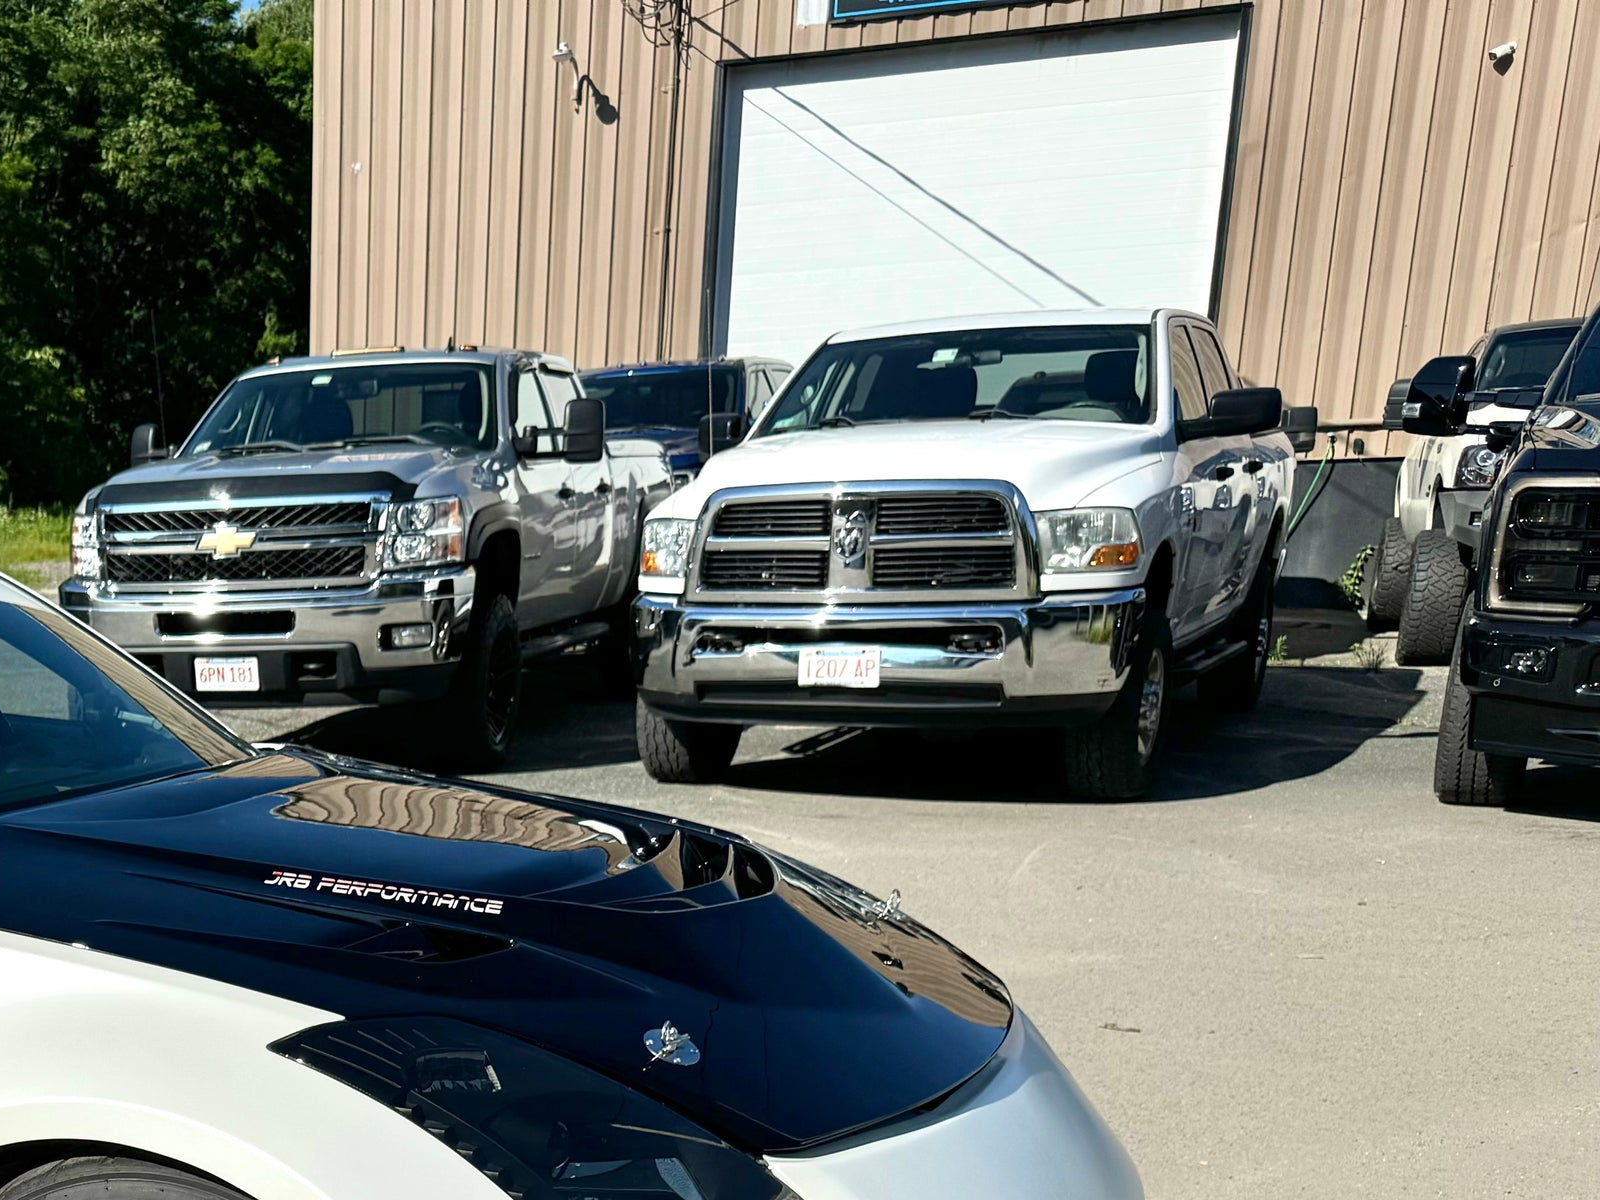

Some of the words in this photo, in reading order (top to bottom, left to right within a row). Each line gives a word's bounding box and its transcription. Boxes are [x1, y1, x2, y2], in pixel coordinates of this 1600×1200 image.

[200, 667, 226, 683] 6PN
[230, 667, 255, 683] 181
[854, 659, 876, 678] AP
[264, 871, 312, 889] JRB
[316, 877, 503, 914] PERFORMANCE
